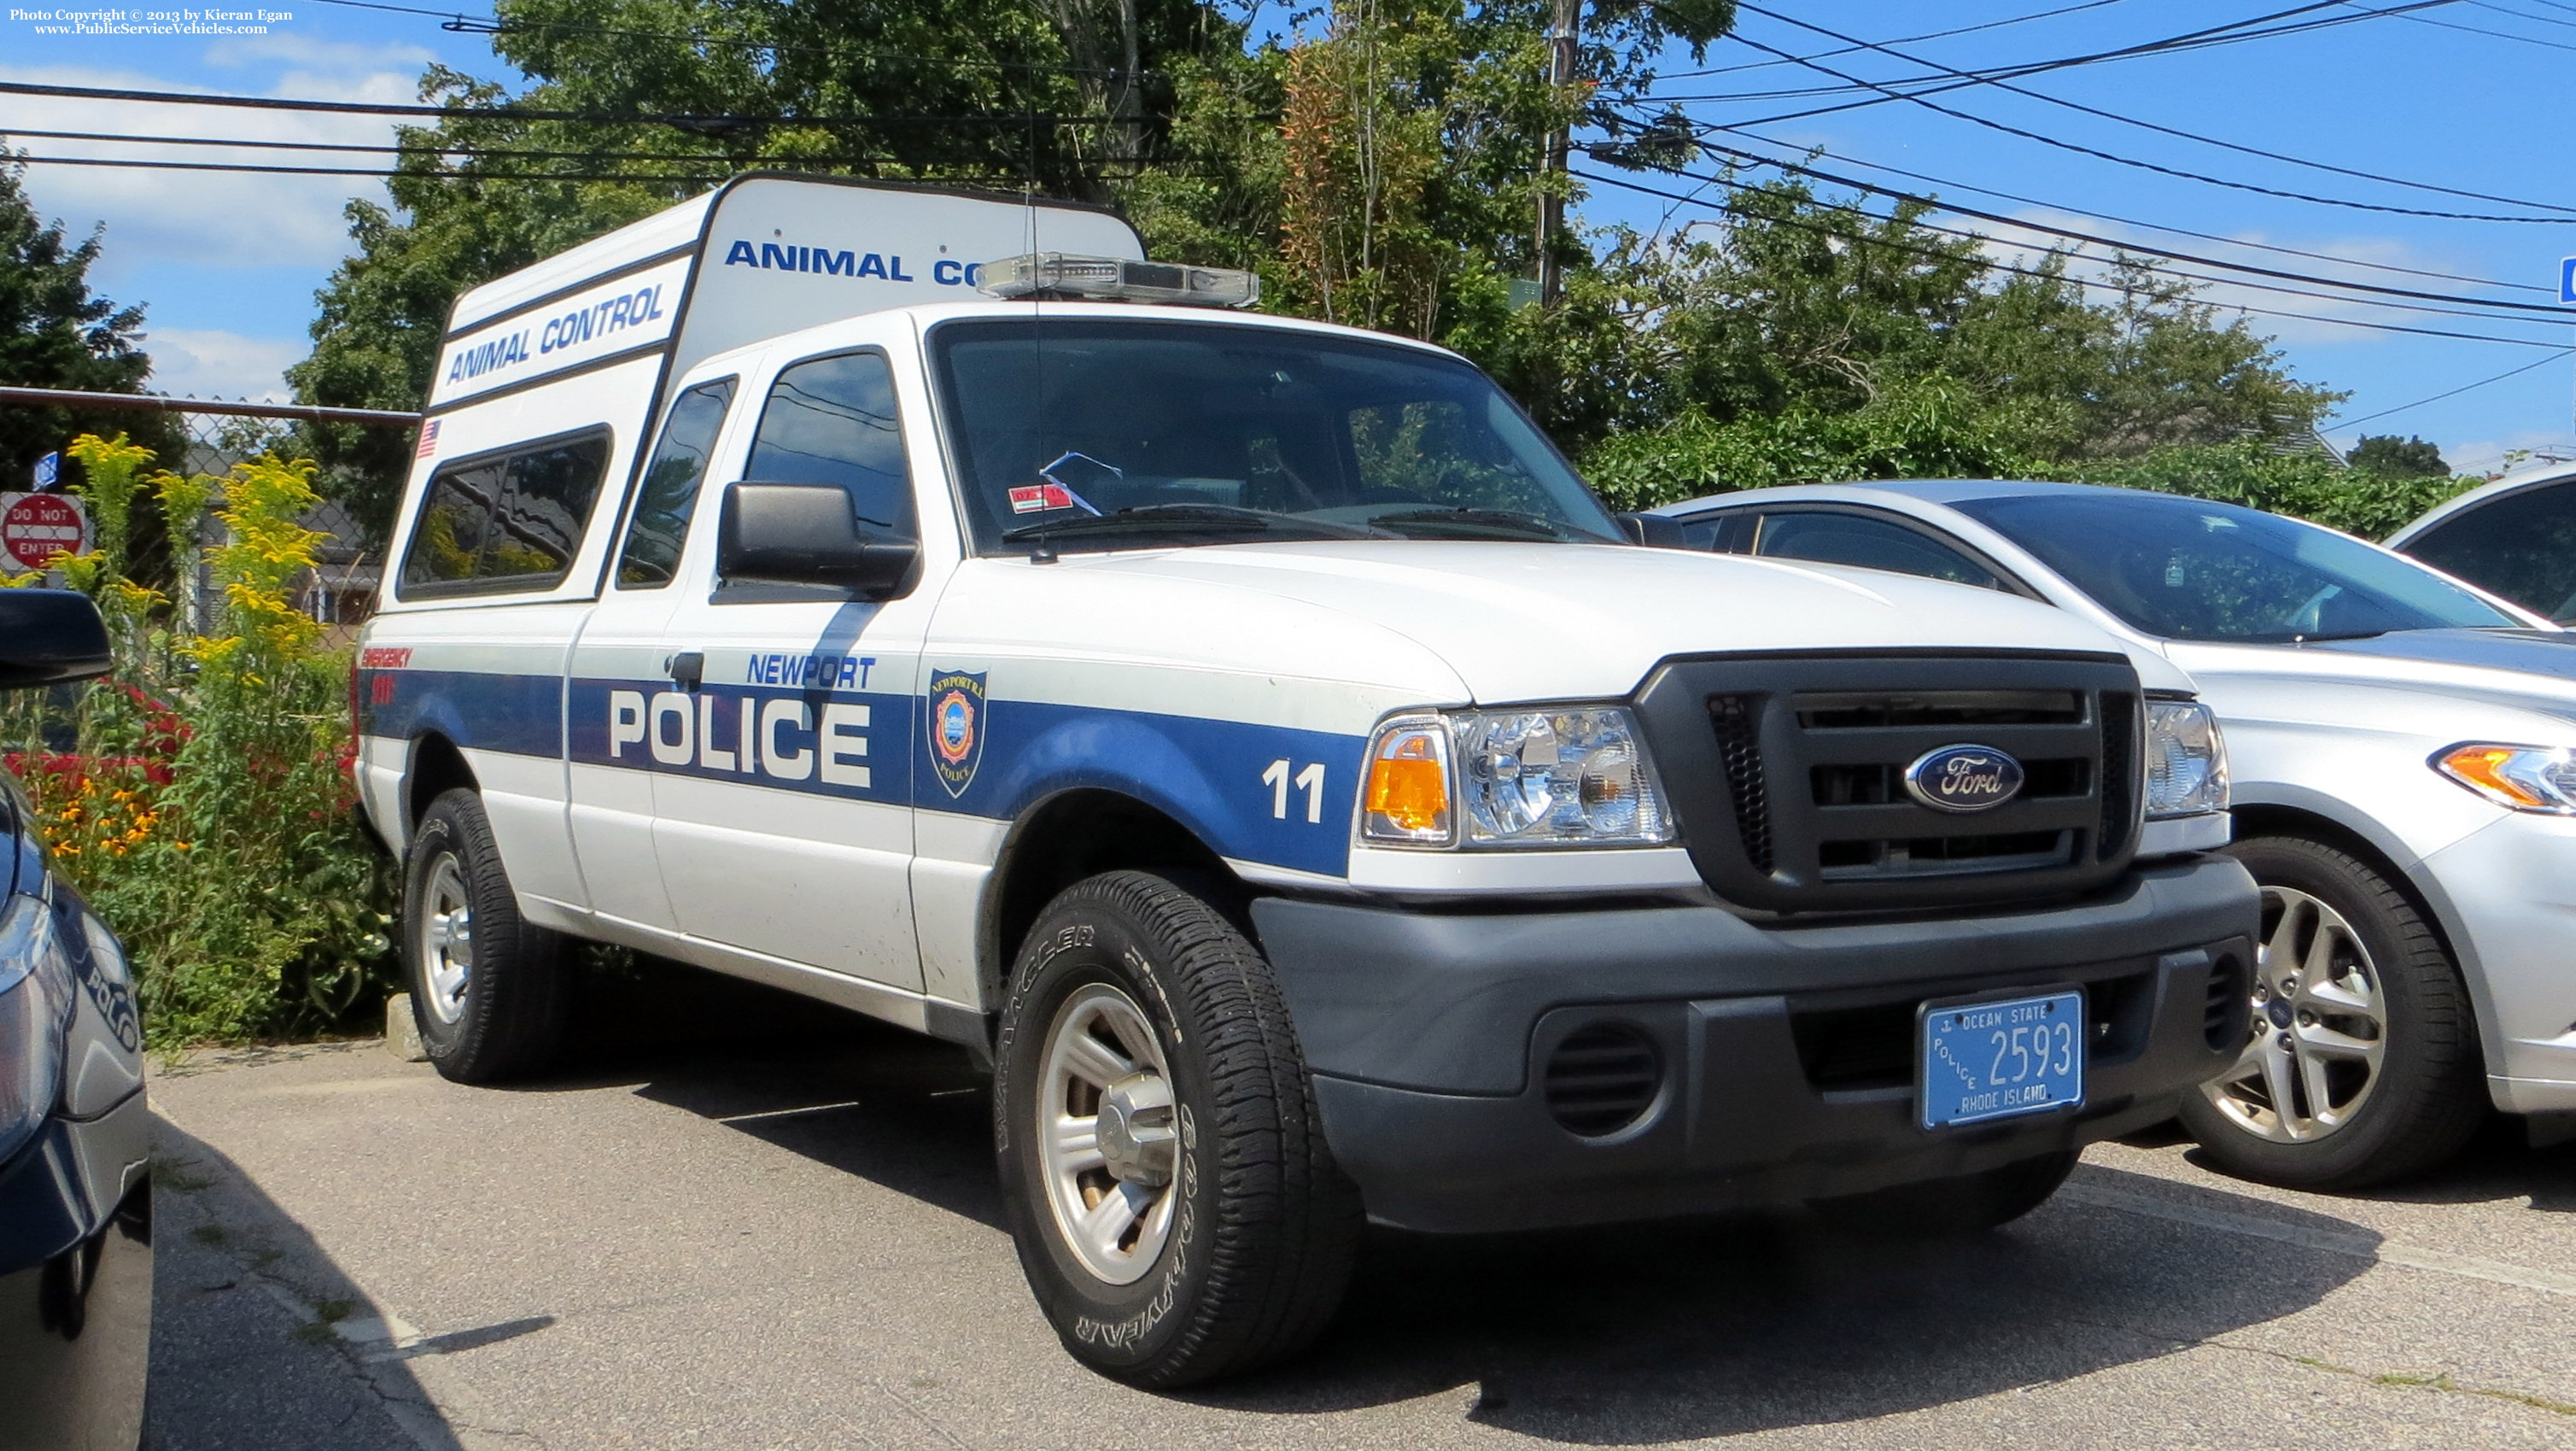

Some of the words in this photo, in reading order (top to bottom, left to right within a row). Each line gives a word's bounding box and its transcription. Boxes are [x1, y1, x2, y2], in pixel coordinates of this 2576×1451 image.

[725, 239, 914, 283] ANIMAL
[446, 328, 531, 387] ANIMAL
[540, 283, 665, 355] CONTROL
[12, 508, 32, 521] DO
[40, 509, 68, 522] NOT
[747, 654, 876, 689] NEWPORT
[932, 676, 972, 693] NEWPORT
[609, 689, 872, 789] POLICE
[940, 763, 970, 781] POLICE
[1262, 758, 1326, 824] 11
[1941, 757, 2003, 795] Ford
[1963, 1012, 2002, 1031] OCEAN
[2011, 1005, 2047, 1024] STATE
[1934, 1038, 1977, 1090] POLICE
[1989, 1022, 2071, 1086] 2593
[1962, 1091, 1999, 1113] RHODE
[2004, 1084, 2047, 1106] ISLAND
